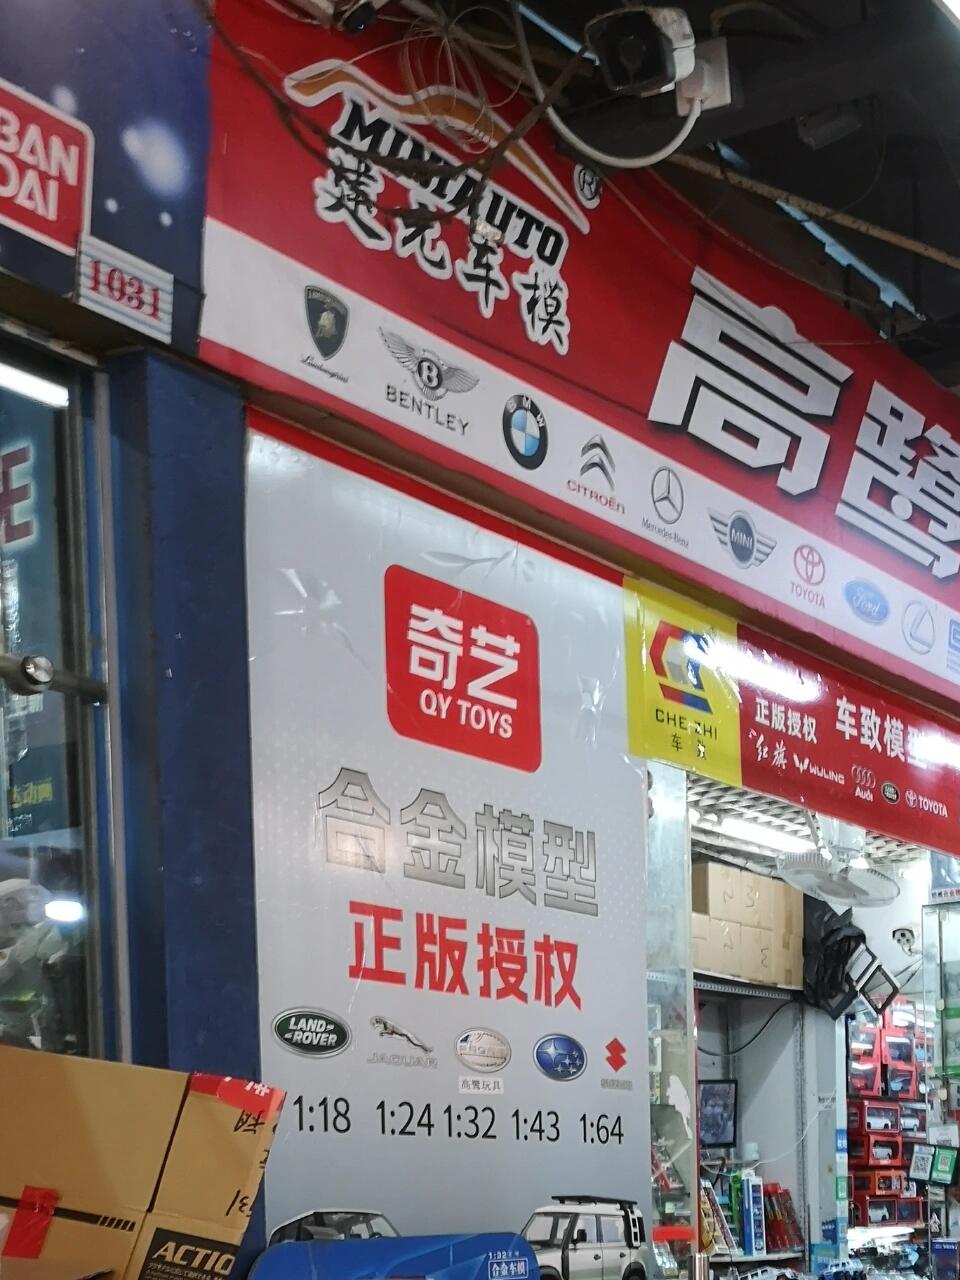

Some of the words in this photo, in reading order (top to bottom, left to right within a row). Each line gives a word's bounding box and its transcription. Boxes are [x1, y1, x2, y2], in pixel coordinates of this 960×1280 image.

[89, 258, 162, 321] 1031
[385, 383, 470, 437] BENTLEY
[730, 527, 755, 550] MINI
[790, 582, 827, 609] TOYOTA
[406, 606, 521, 710] 奇艺
[418, 690, 453, 721] QY
[457, 698, 513, 741] TOYS
[754, 696, 818, 745] 正版授权
[854, 786, 874, 803] Audi
[918, 797, 949, 818] TOYOTA
[317, 767, 600, 918] 合金模型
[348, 899, 582, 1012] 正版授权
[287, 1016, 327, 1034] LAND
[291, 1031, 338, 1048] ROVER
[366, 1052, 439, 1070] JAGUAR
[292, 1094, 352, 1135] 1:18
[375, 1099, 435, 1138] 1:24
[442, 1103, 497, 1140] 1:32
[511, 1107, 561, 1143] 1:43
[579, 1112, 625, 1145] 1:64
